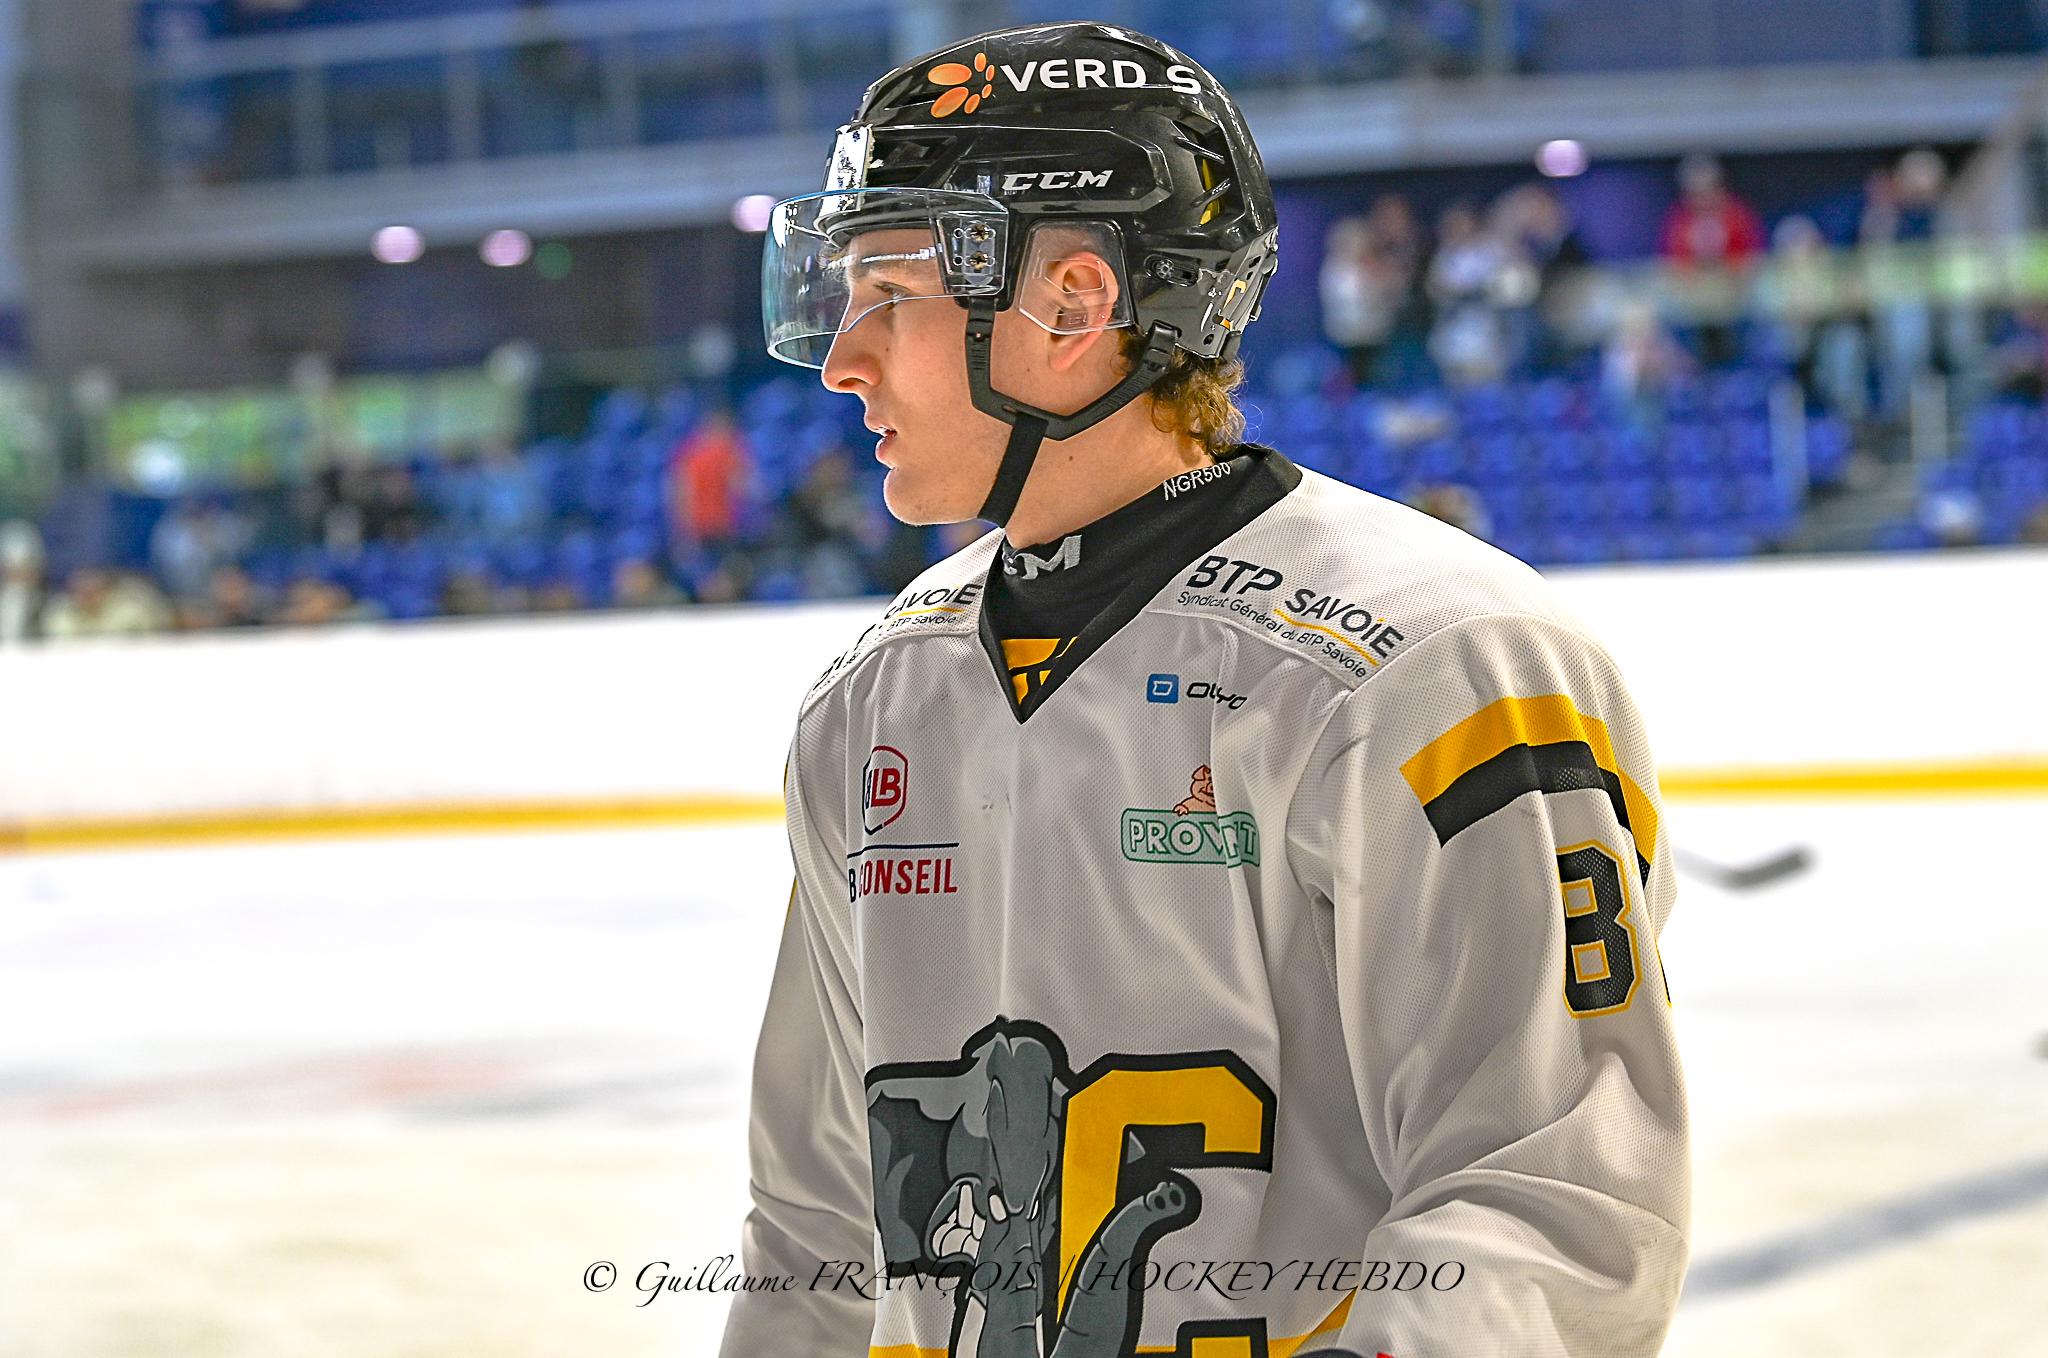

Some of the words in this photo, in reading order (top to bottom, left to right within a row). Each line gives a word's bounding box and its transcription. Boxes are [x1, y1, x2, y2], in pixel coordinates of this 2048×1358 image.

[1000, 58, 1201, 95] VERDS
[1001, 169, 1114, 192] CCM
[1162, 462, 1231, 501] NGR500
[1186, 555, 1284, 595] BTP
[1177, 591, 1229, 608] Syndicat
[1230, 599, 1284, 633] Général
[1280, 629, 1298, 641] du
[1296, 632, 1325, 647] BTP
[1322, 641, 1367, 678] Savoie
